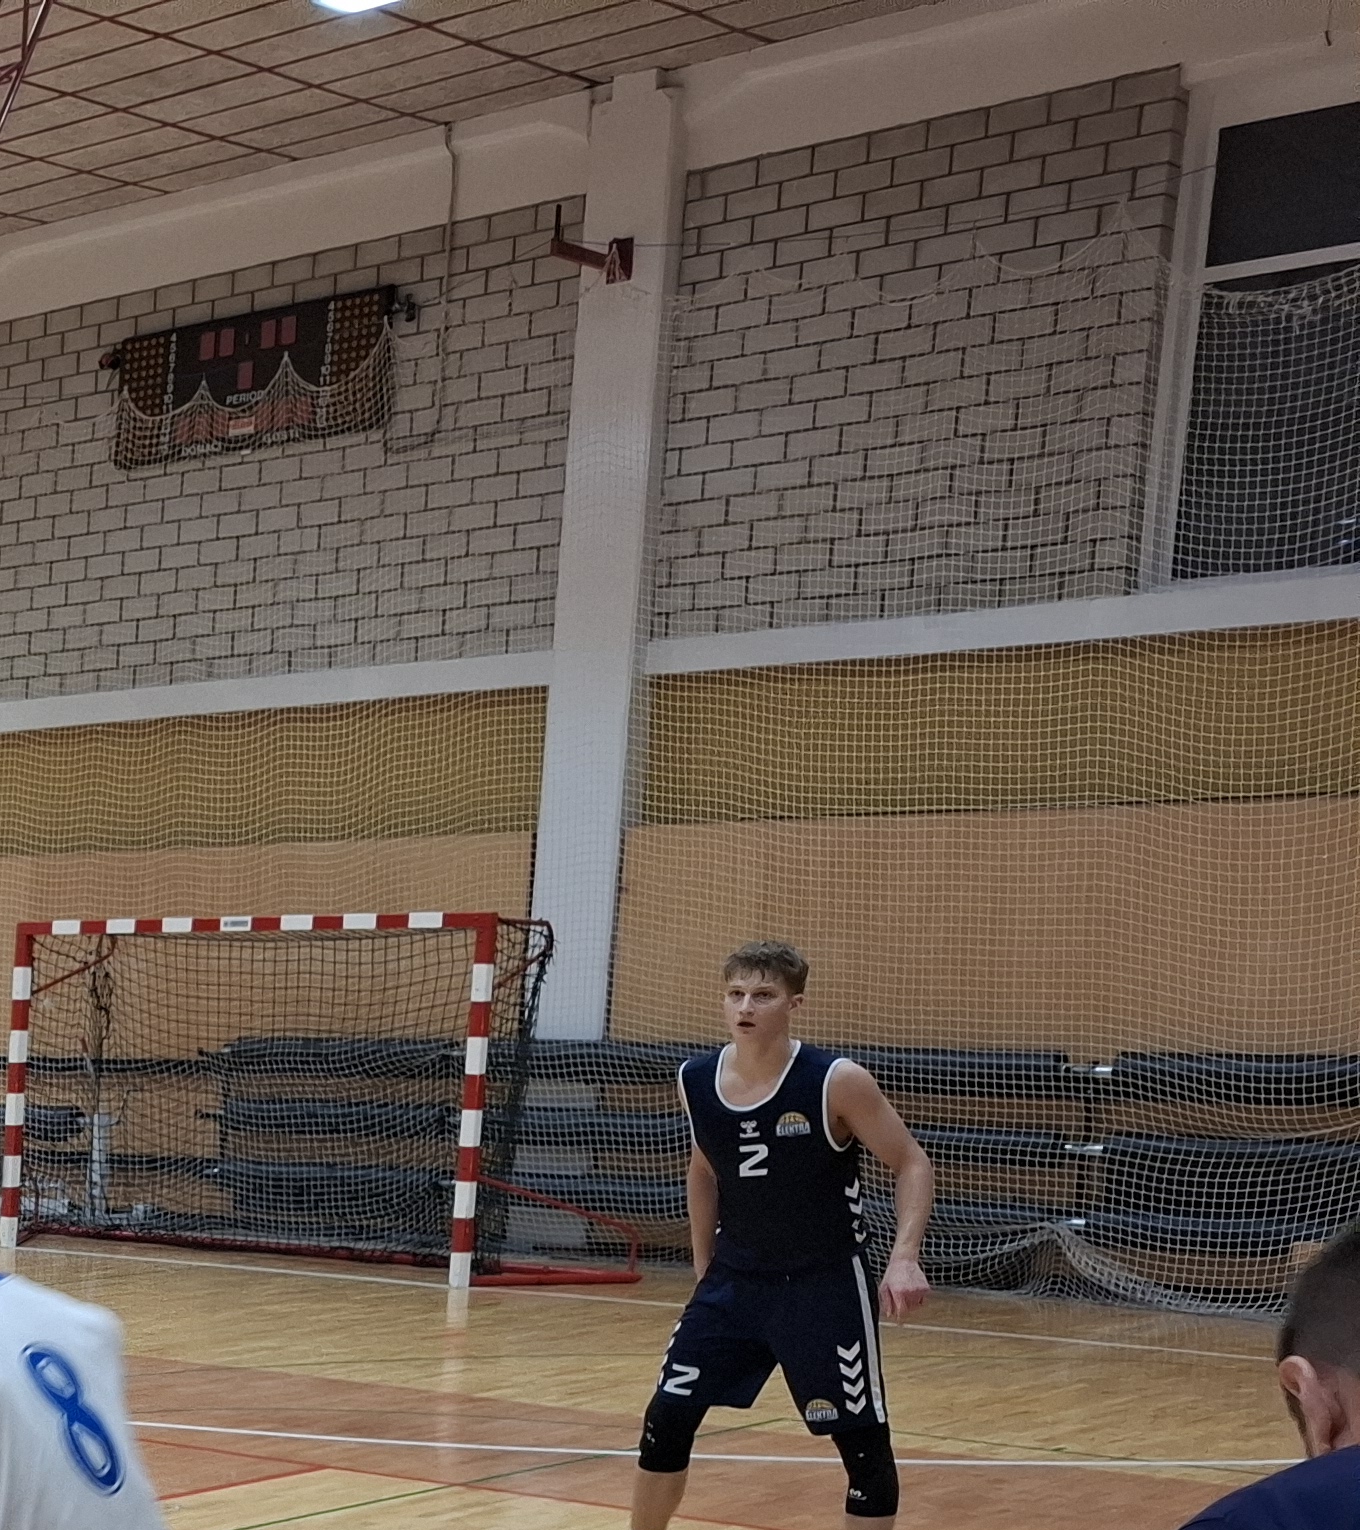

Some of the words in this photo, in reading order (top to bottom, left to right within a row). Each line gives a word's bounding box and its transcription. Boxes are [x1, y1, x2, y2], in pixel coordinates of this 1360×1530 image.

[225, 390, 265, 406] PERIOD
[739, 1144, 768, 1177] 2
[662, 1363, 701, 1396] 2
[21, 1341, 127, 1497] 8
